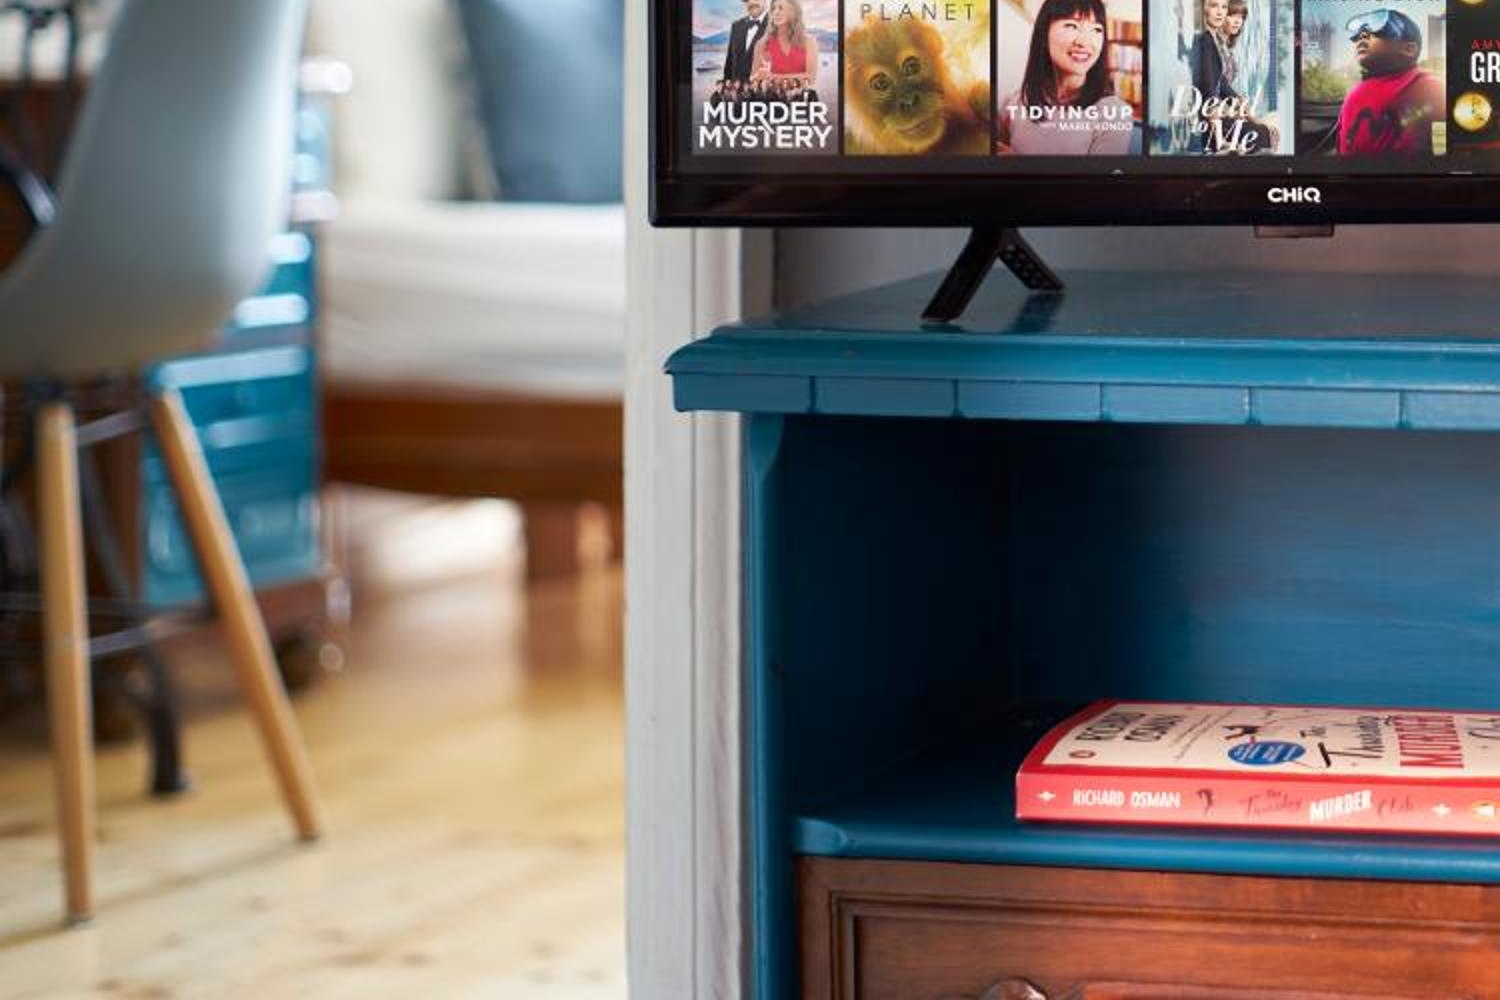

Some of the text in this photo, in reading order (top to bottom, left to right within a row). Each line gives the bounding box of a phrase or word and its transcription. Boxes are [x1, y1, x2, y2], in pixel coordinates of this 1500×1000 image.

[861, 3, 974, 21] PLANET
[703, 101, 828, 125] MURDER
[699, 124, 833, 149] MYSTERY
[1204, 119, 1259, 153] Me
[1072, 788, 1182, 809] RICHARD OSMAN
[1309, 788, 1373, 824] MURDER
